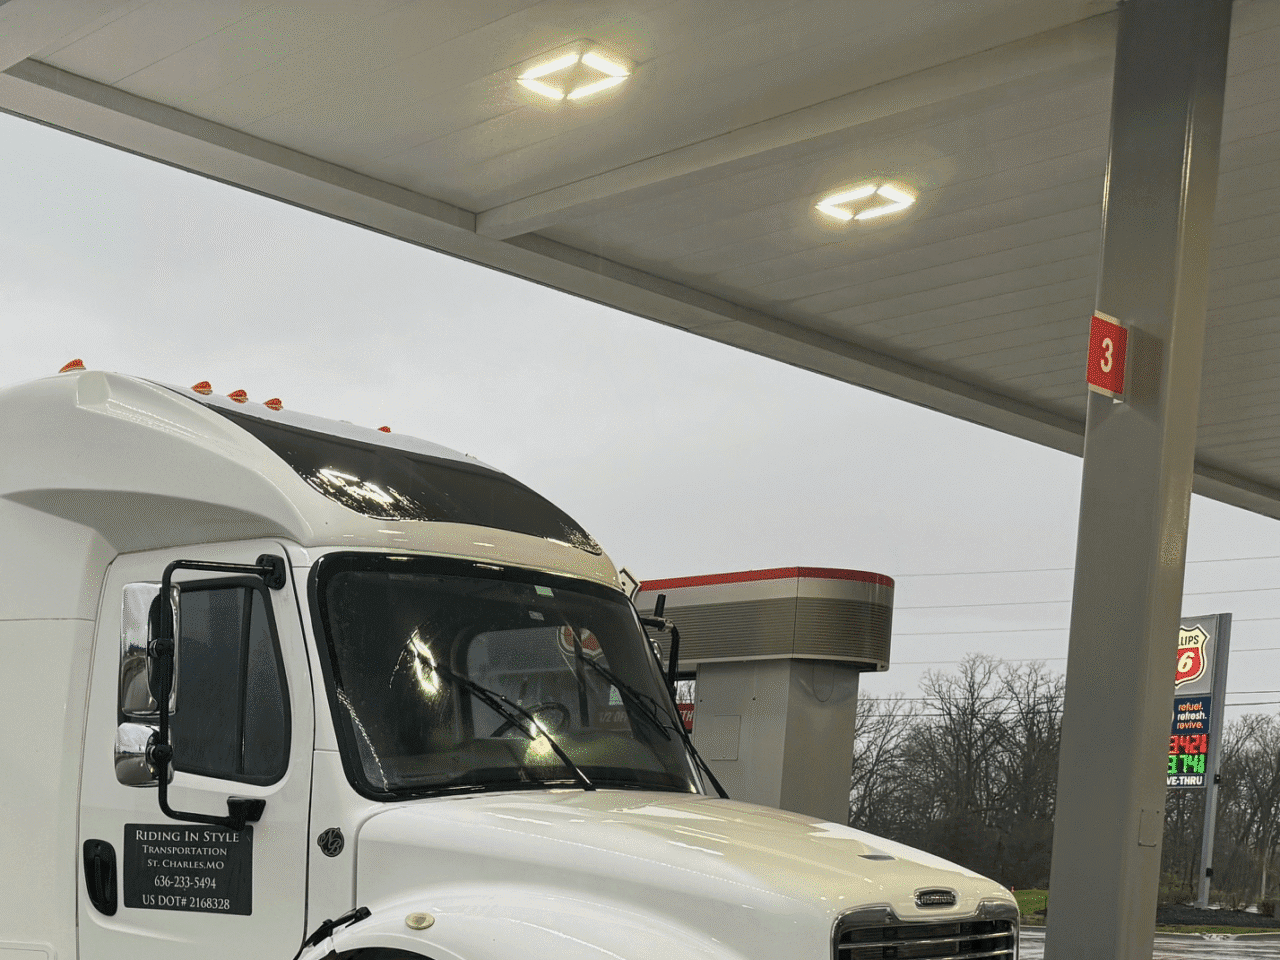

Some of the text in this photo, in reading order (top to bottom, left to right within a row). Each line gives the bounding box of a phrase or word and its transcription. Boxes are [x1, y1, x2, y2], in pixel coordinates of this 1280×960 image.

[1101, 337, 1113, 373] 3
[1180, 635, 1199, 646] LIPS
[1177, 651, 1195, 673] 6
[1166, 775, 1203, 786] VE-THRU
[136, 830, 239, 843] RIDING IN STYLE
[142, 844, 228, 856] TRANSPORTATION
[154, 875, 217, 890] 636-233-5494
[142, 894, 230, 910] US DOT# 2168328
